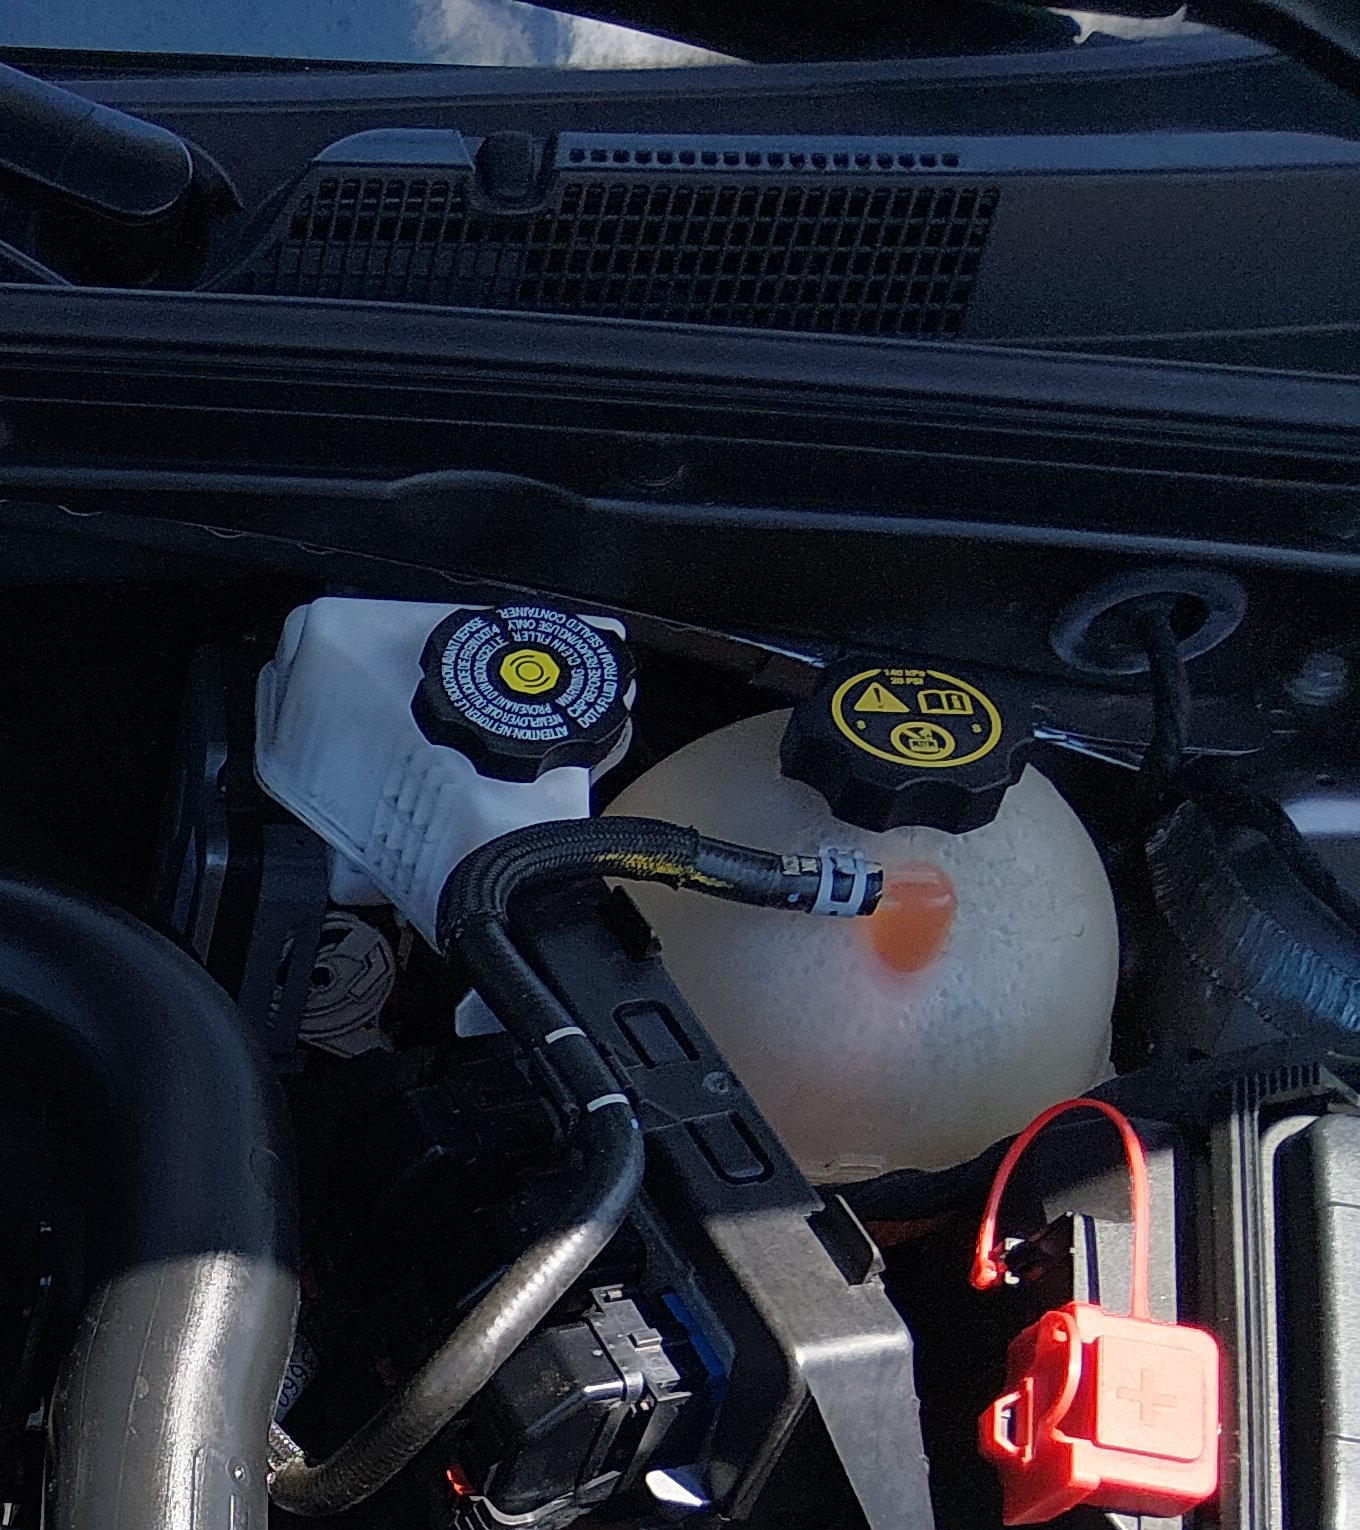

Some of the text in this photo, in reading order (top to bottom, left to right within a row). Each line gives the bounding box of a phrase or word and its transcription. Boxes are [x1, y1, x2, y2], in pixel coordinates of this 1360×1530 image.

[507, 619, 535, 629] ONLY
[566, 618, 603, 647] SEALED
[512, 631, 551, 644] FILLER
[551, 638, 580, 665] CLEAN
[600, 652, 616, 679] FROM
[581, 668, 599, 702] BEFORE
[597, 681, 616, 707] FLUID
[567, 699, 589, 718] CAP
